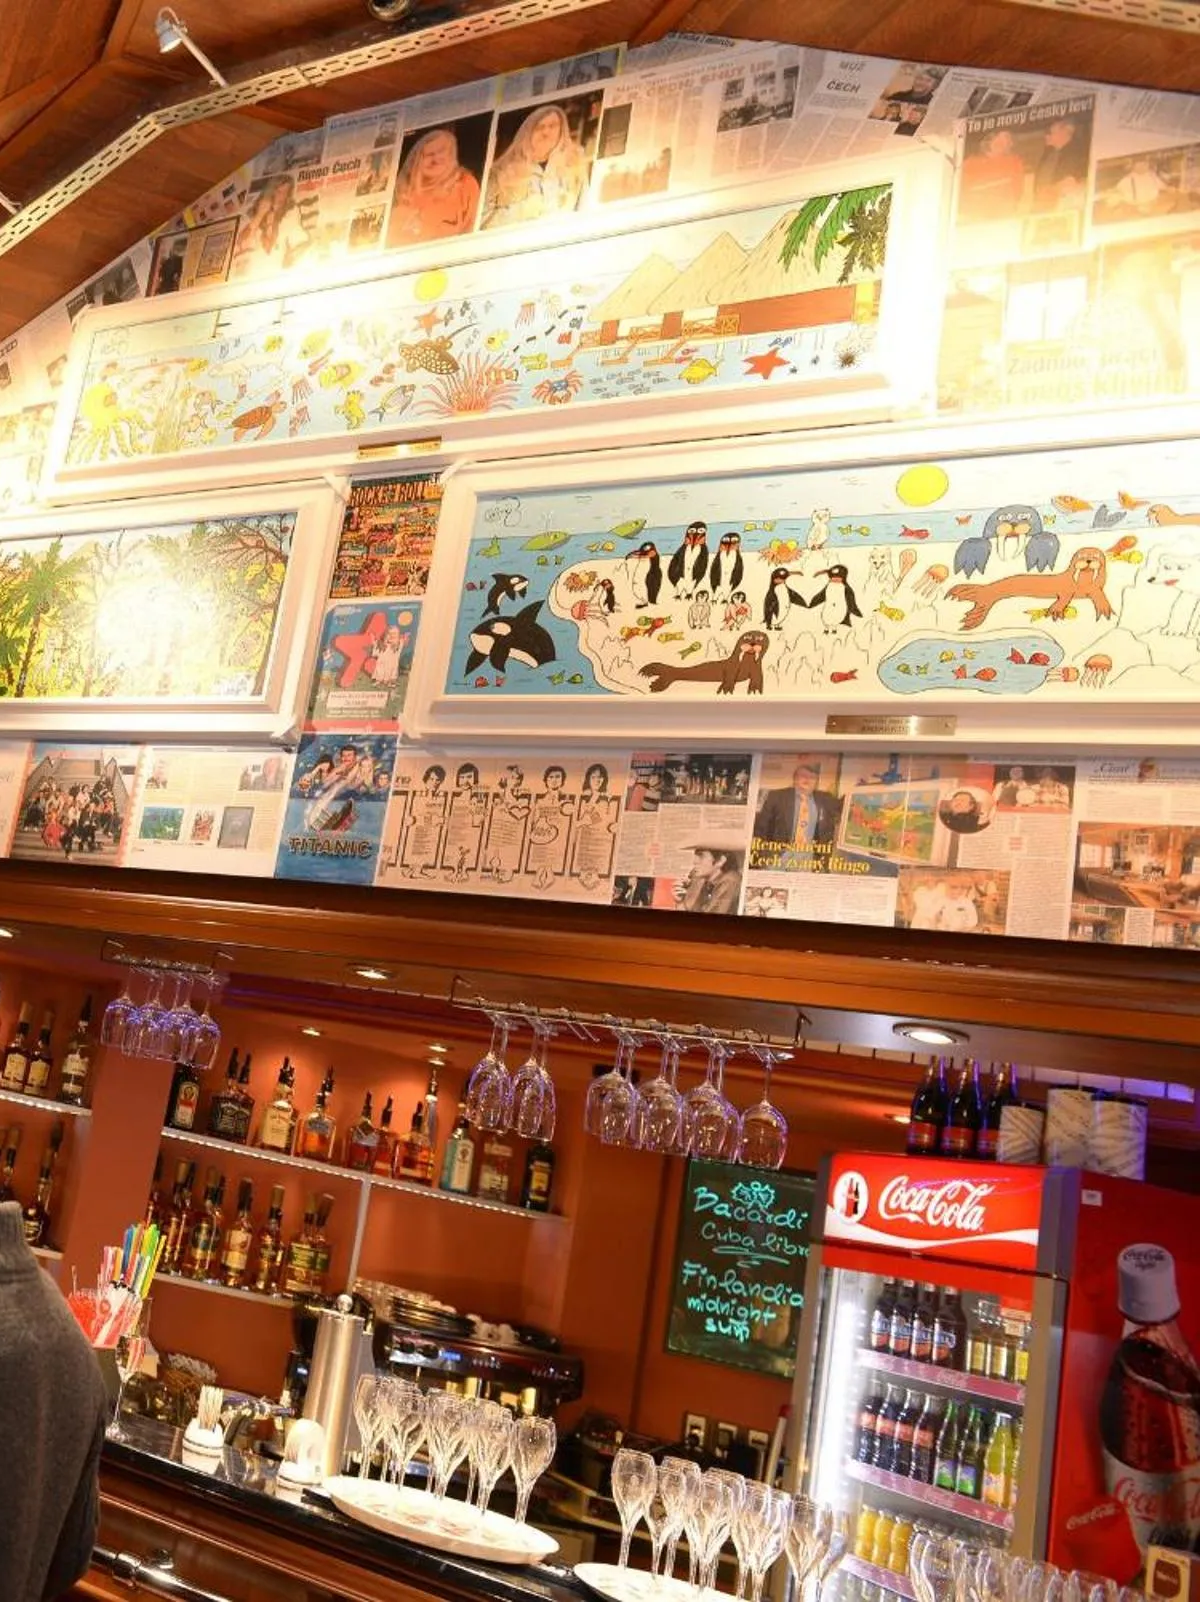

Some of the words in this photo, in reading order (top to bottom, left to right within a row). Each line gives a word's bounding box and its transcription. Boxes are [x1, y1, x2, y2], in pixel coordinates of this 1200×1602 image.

[967, 118, 983, 133] To
[331, 158, 362, 174] Čech
[288, 837, 373, 860] TITANIC
[748, 850, 782, 868] Čech
[827, 856, 871, 874] Ringo
[693, 1186, 808, 1230] Bacardi
[877, 1175, 996, 1231] Coca-Cola
[701, 1221, 756, 1247] Cuba
[681, 1260, 805, 1309] Finlandia
[686, 1293, 777, 1327] midnight
